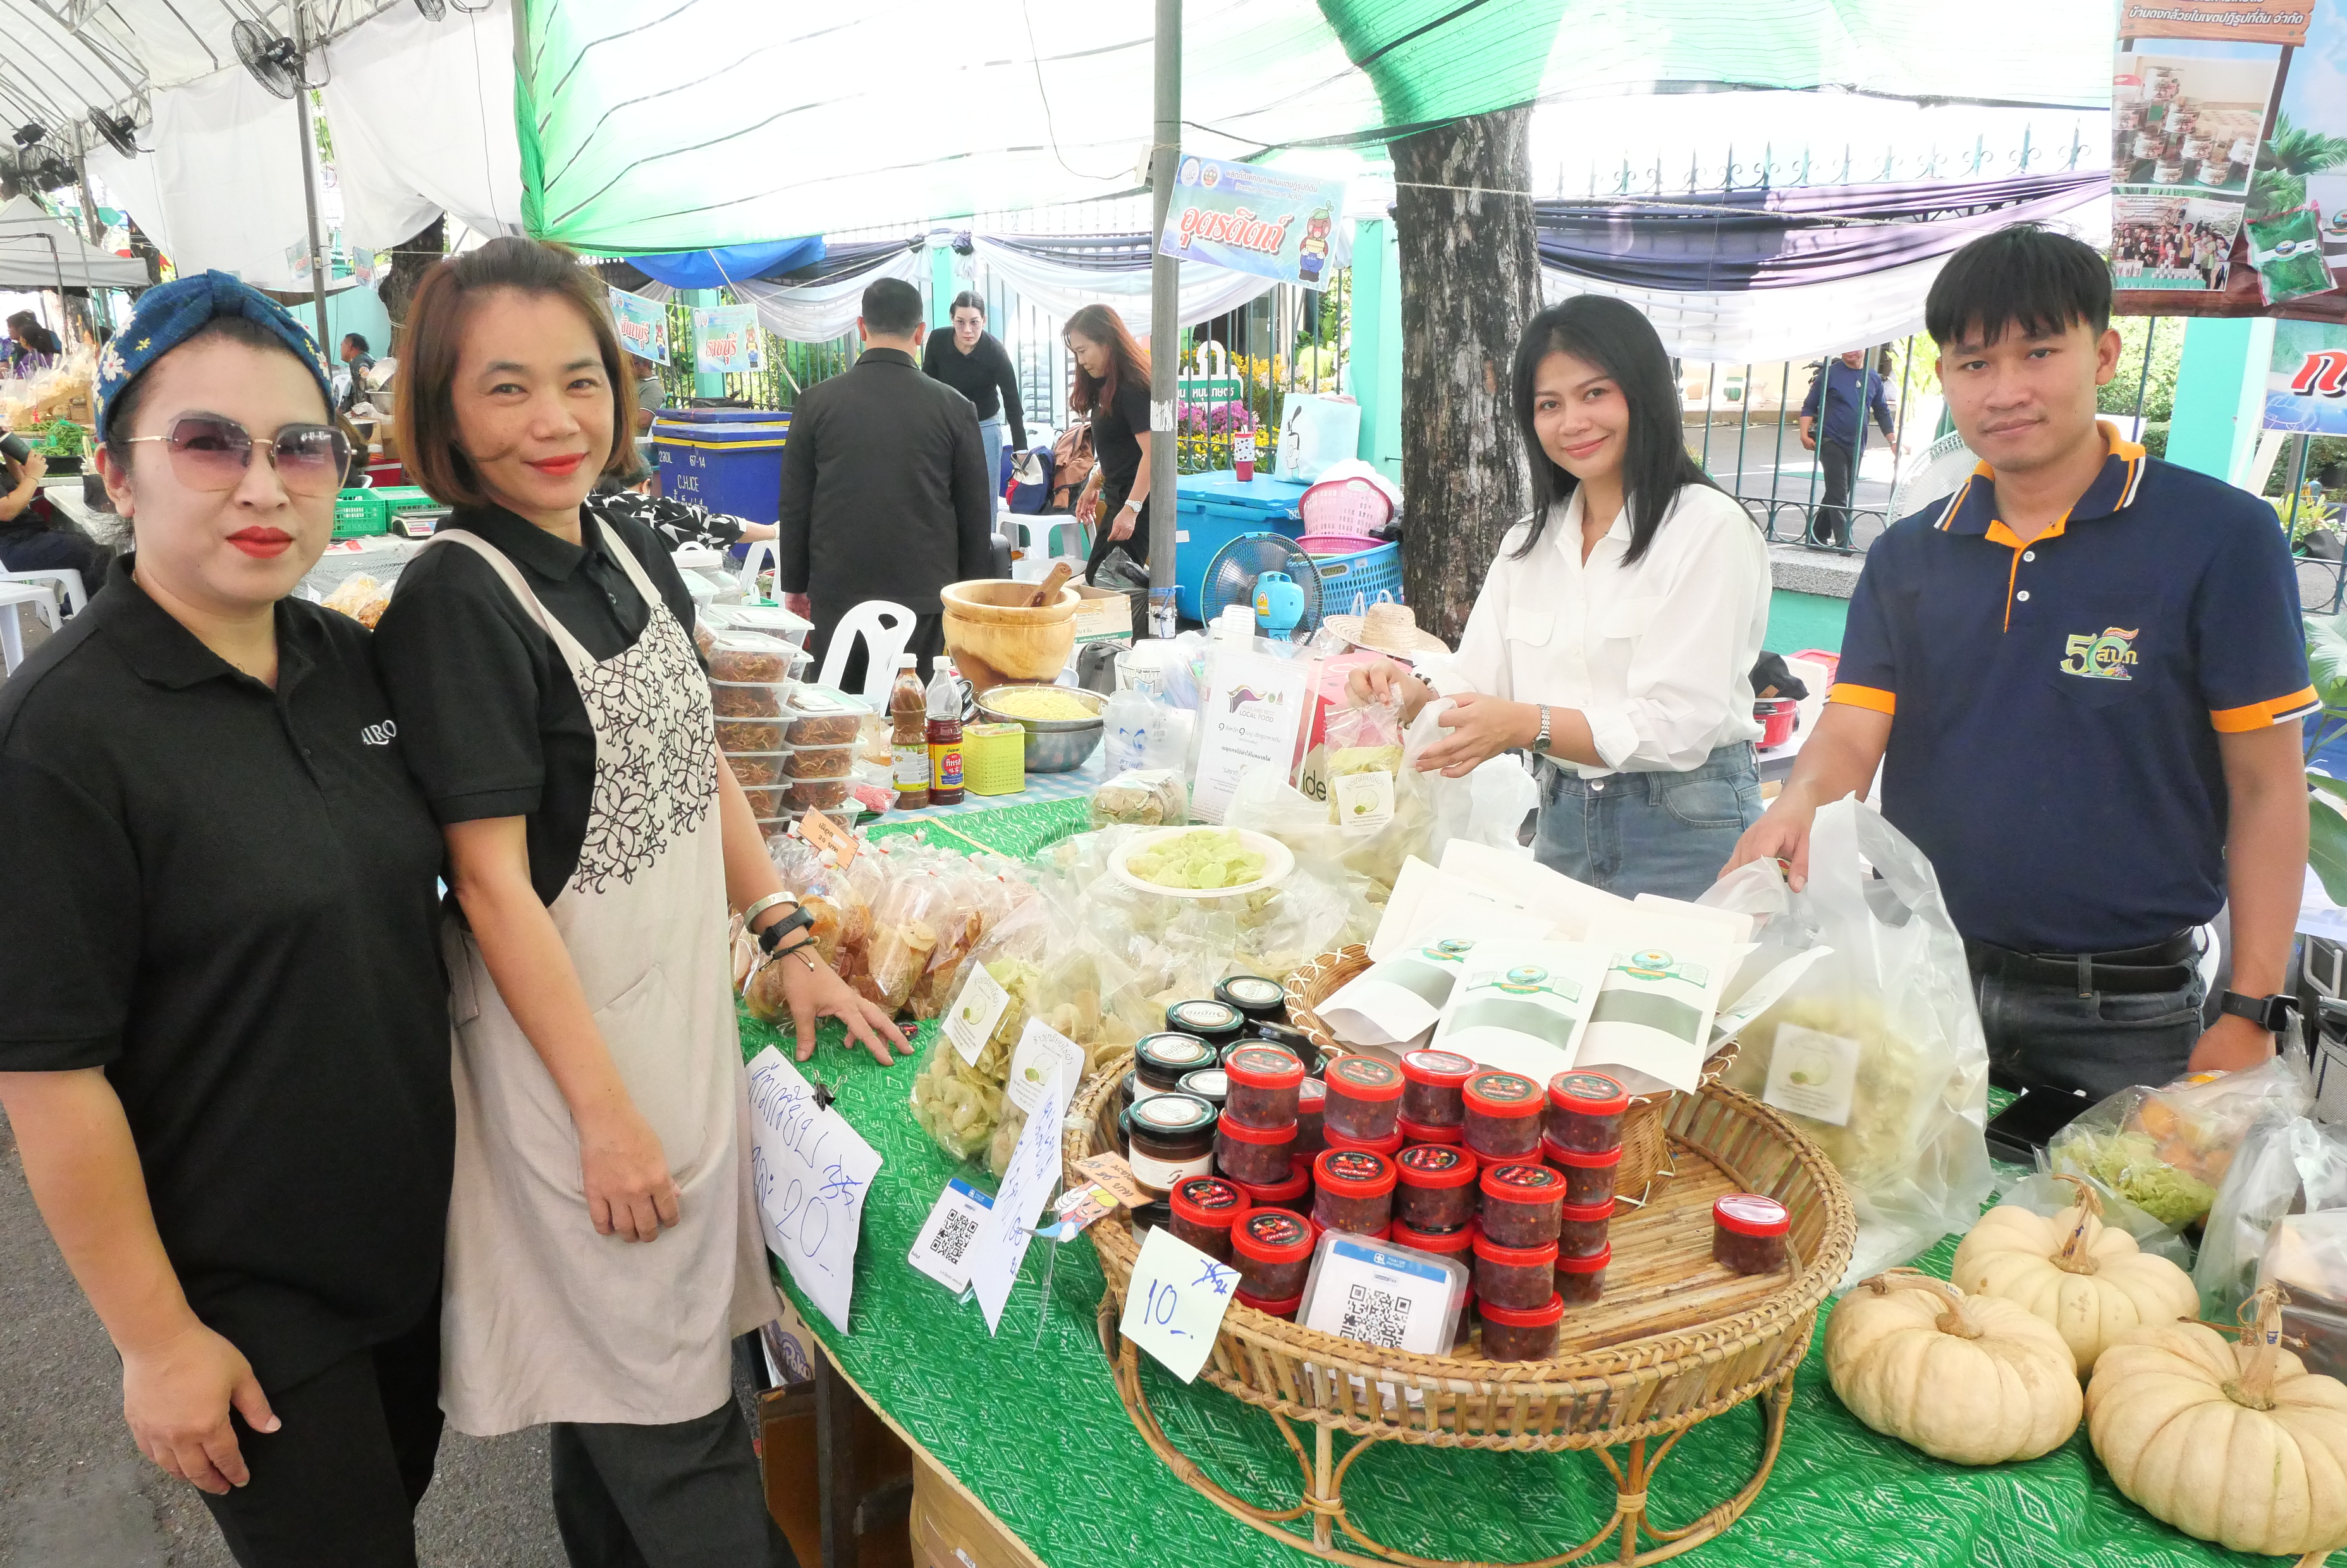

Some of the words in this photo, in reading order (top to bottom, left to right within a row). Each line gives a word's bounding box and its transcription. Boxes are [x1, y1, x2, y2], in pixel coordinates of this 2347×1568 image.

[2274, 11, 2305, 25] จำกัด
[1258, 188, 1280, 197] Products
[1180, 207, 1295, 252] อุตรดิตถ์
[706, 333, 738, 365] ราชบุรี
[689, 455, 706, 468] 67-14
[677, 474, 699, 492] C.H.ICE
[1239, 710, 1256, 720] LOCAL
[1258, 714, 1274, 723] FOOD
[818, 835, 826, 843] 20
